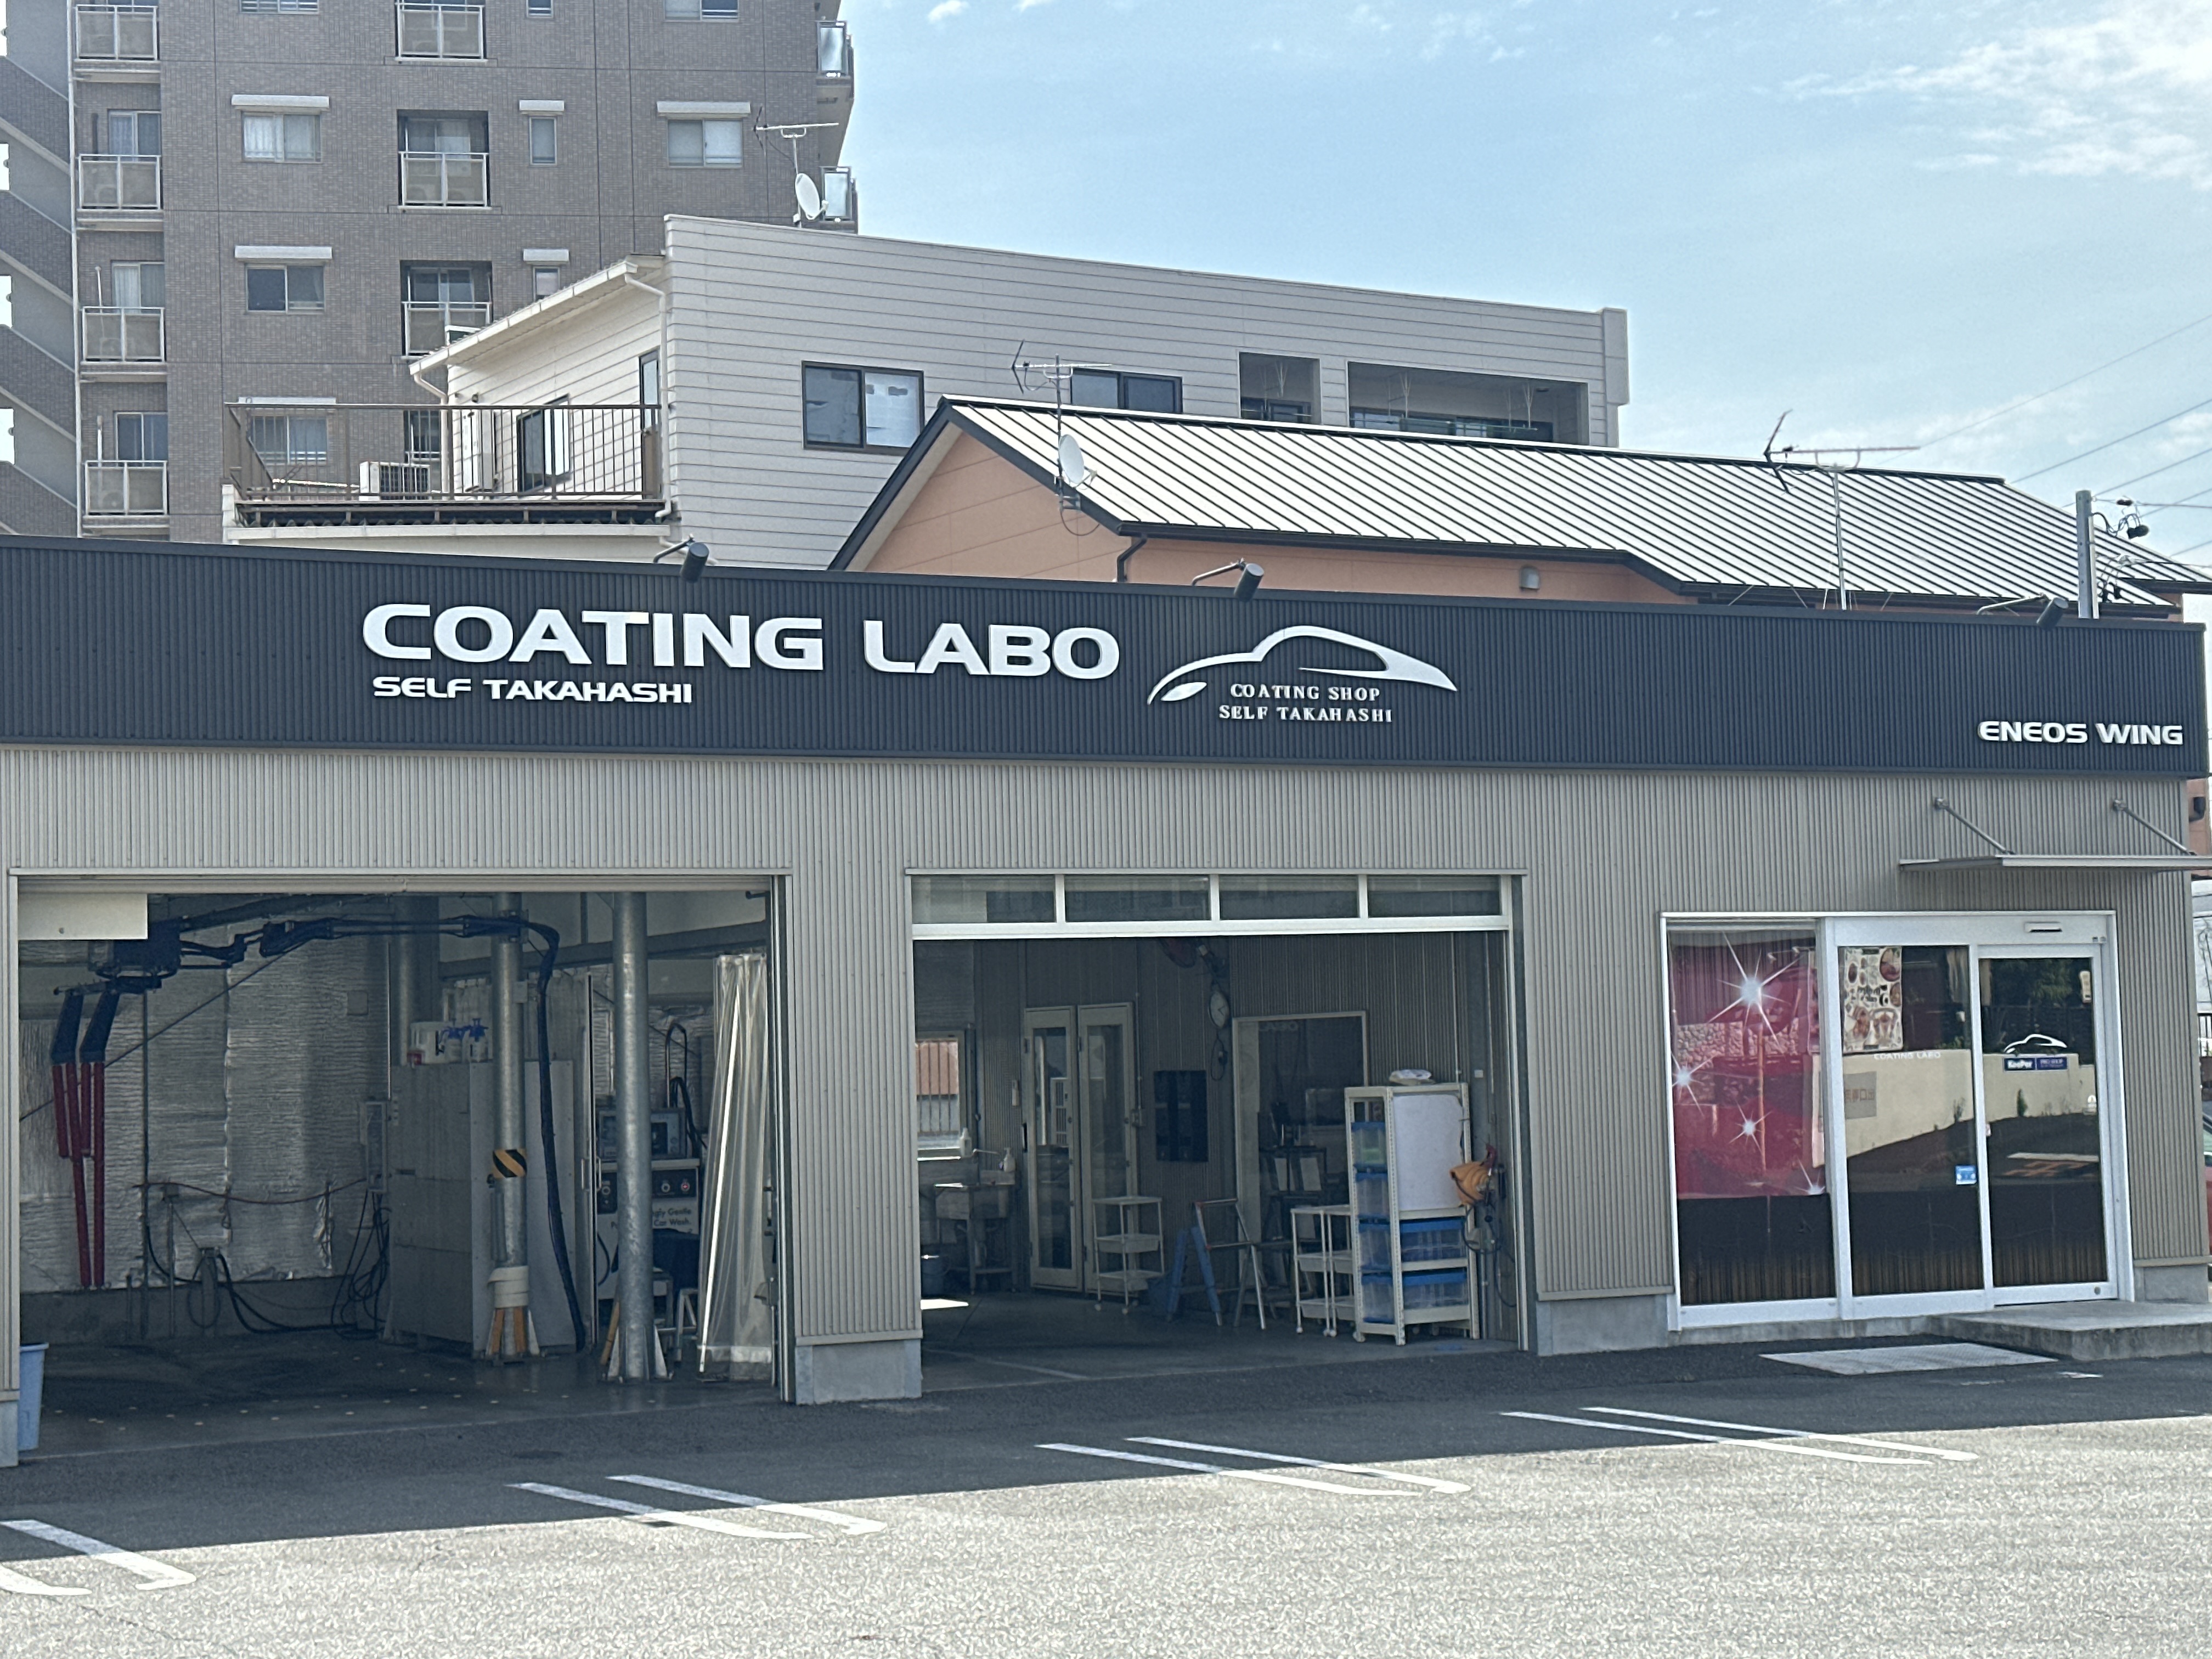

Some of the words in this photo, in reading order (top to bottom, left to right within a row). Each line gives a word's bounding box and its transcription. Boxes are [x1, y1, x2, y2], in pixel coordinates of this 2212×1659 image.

[363, 603, 823, 670] COATING
[864, 620, 1120, 679] LABO
[373, 676, 472, 698] SELF
[482, 679, 692, 704] TAKAHASHI
[1230, 684, 1319, 699] COATING
[1328, 686, 1380, 702] SHOP
[1218, 704, 1268, 720] SELF
[1276, 707, 1392, 723] TAKAHASHI
[1978, 721, 2088, 743] ENEOS
[2095, 723, 2183, 745] WING
